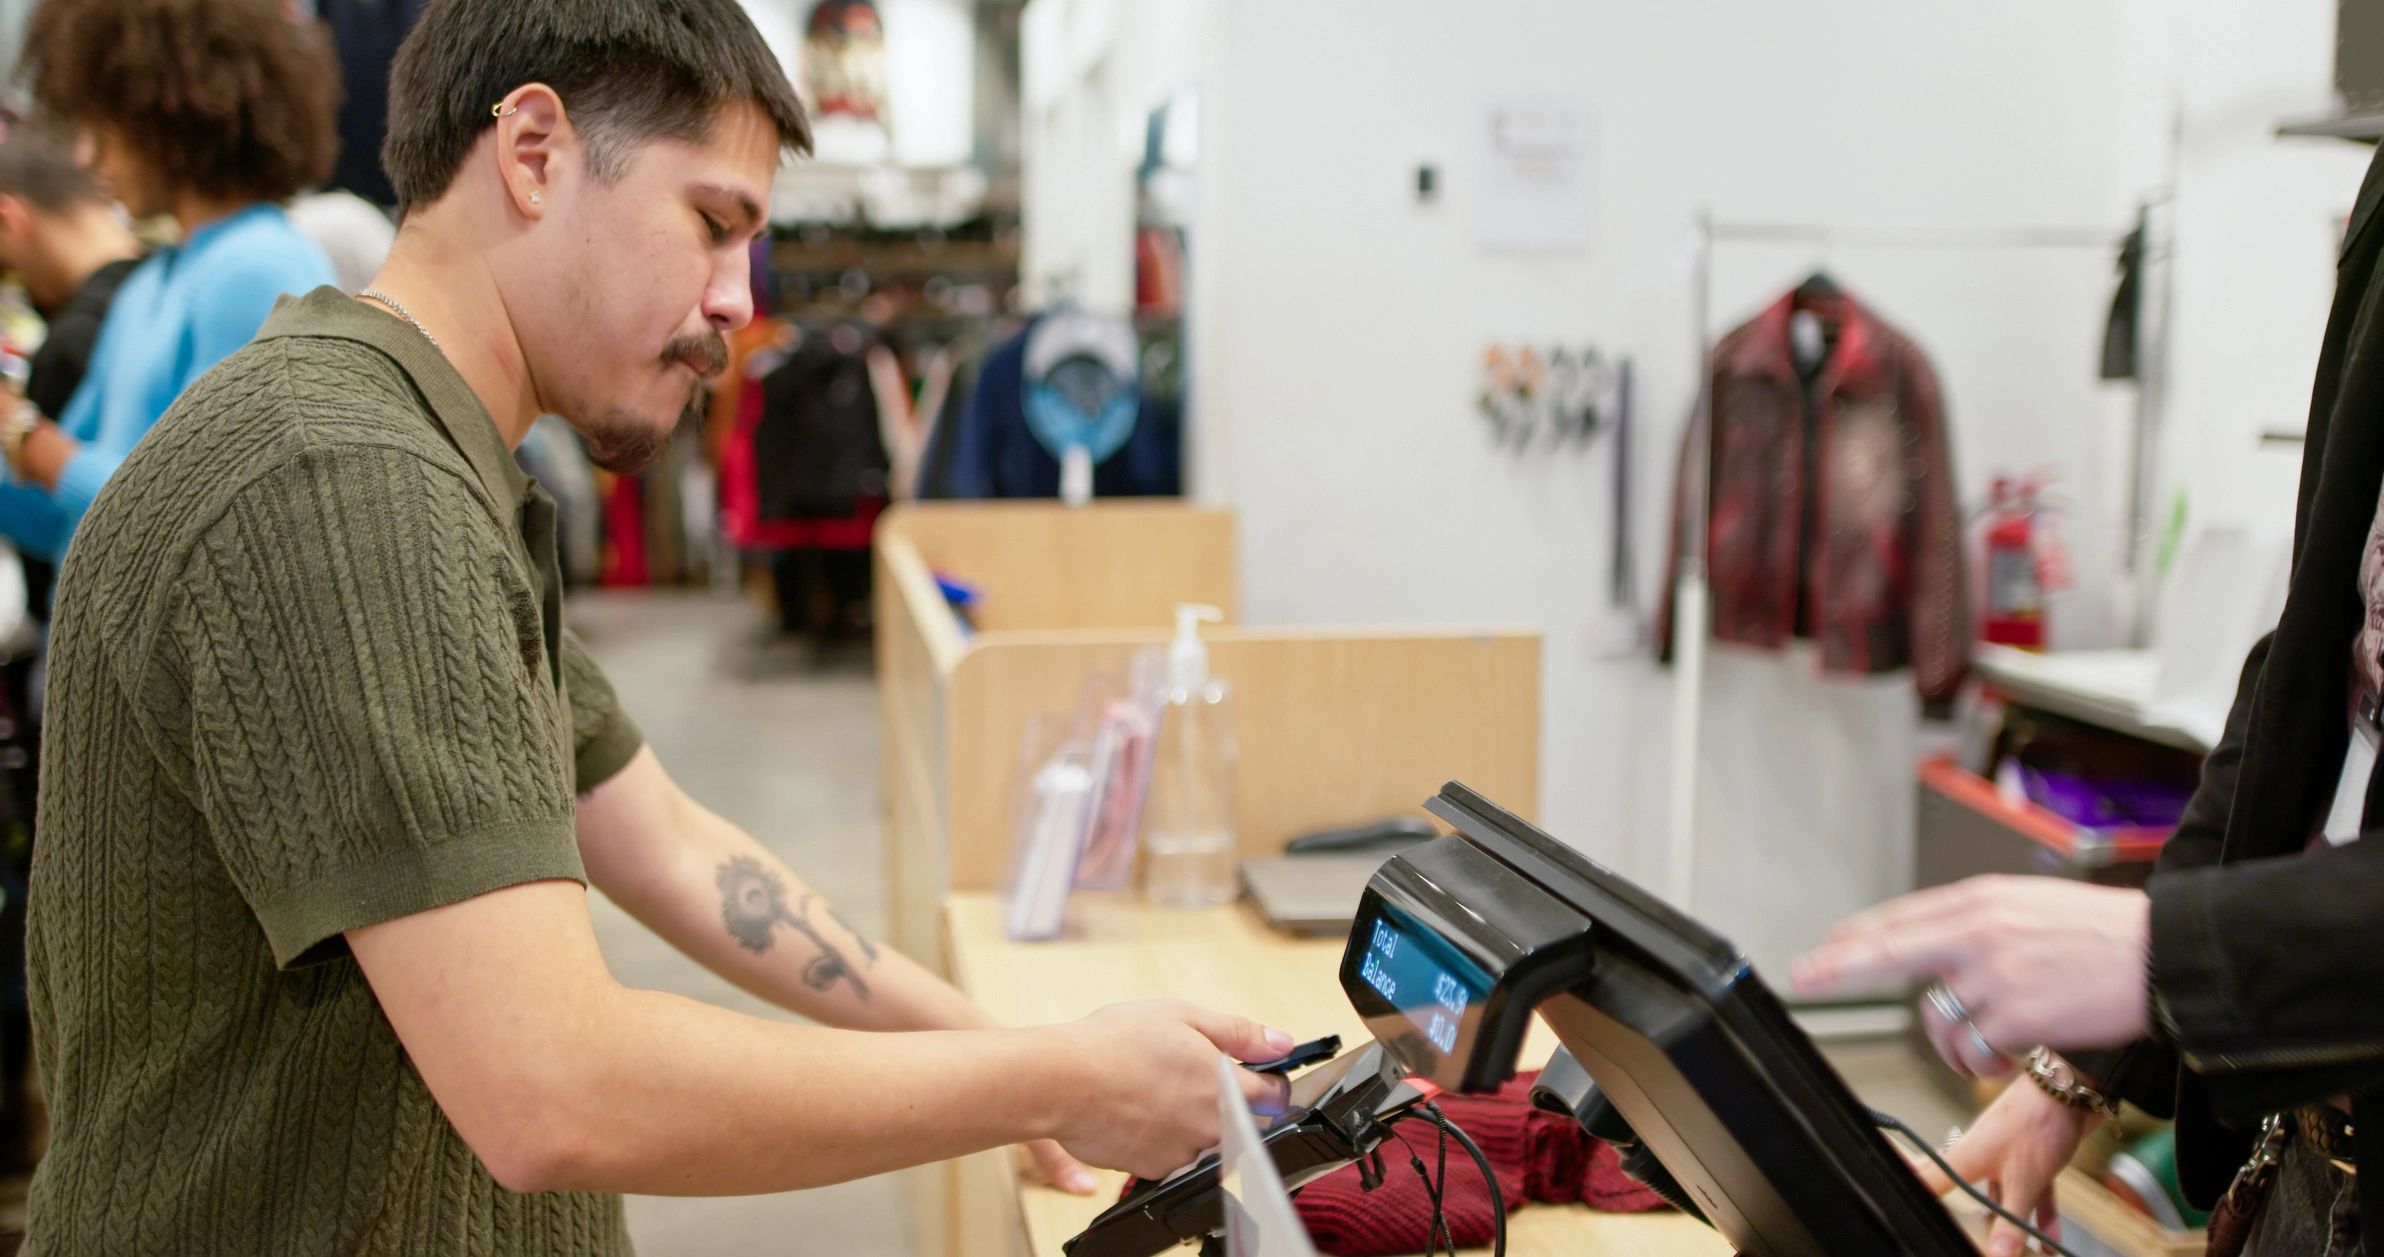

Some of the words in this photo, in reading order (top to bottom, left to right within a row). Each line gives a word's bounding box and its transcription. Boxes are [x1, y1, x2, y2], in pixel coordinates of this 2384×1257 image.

[1362, 952, 1397, 1001] Balance
[1429, 1012, 1458, 1055] $0.0
[1373, 918, 1399, 959] Total
[1435, 972, 1470, 1016] $23.9
